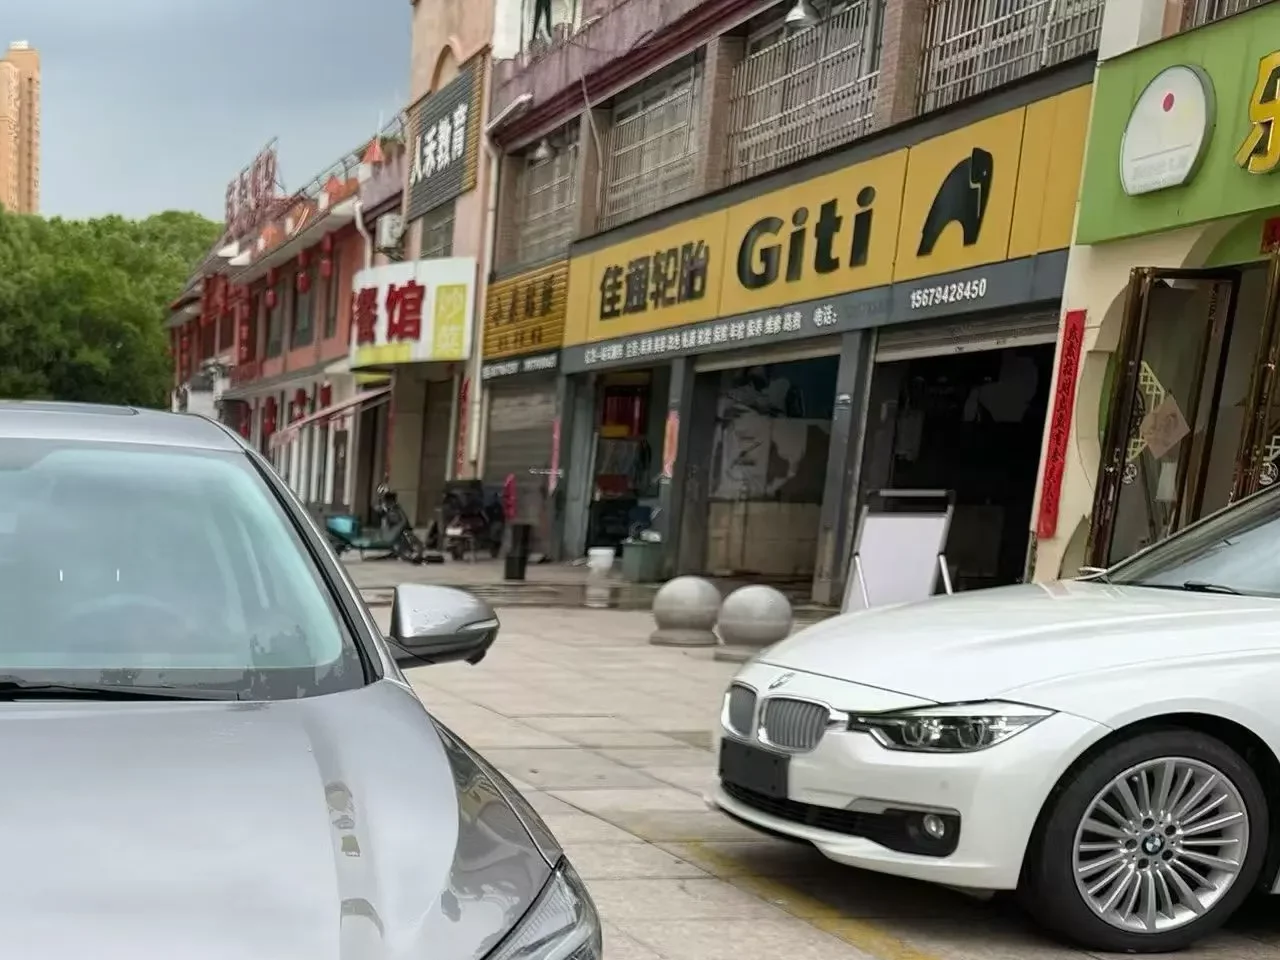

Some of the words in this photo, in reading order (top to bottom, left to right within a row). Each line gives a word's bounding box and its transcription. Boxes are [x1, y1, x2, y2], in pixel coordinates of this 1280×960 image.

[736, 186, 876, 290] Giti
[600, 240, 710, 320] 佳通轮胎
[910, 278, 987, 309] 15679428450
